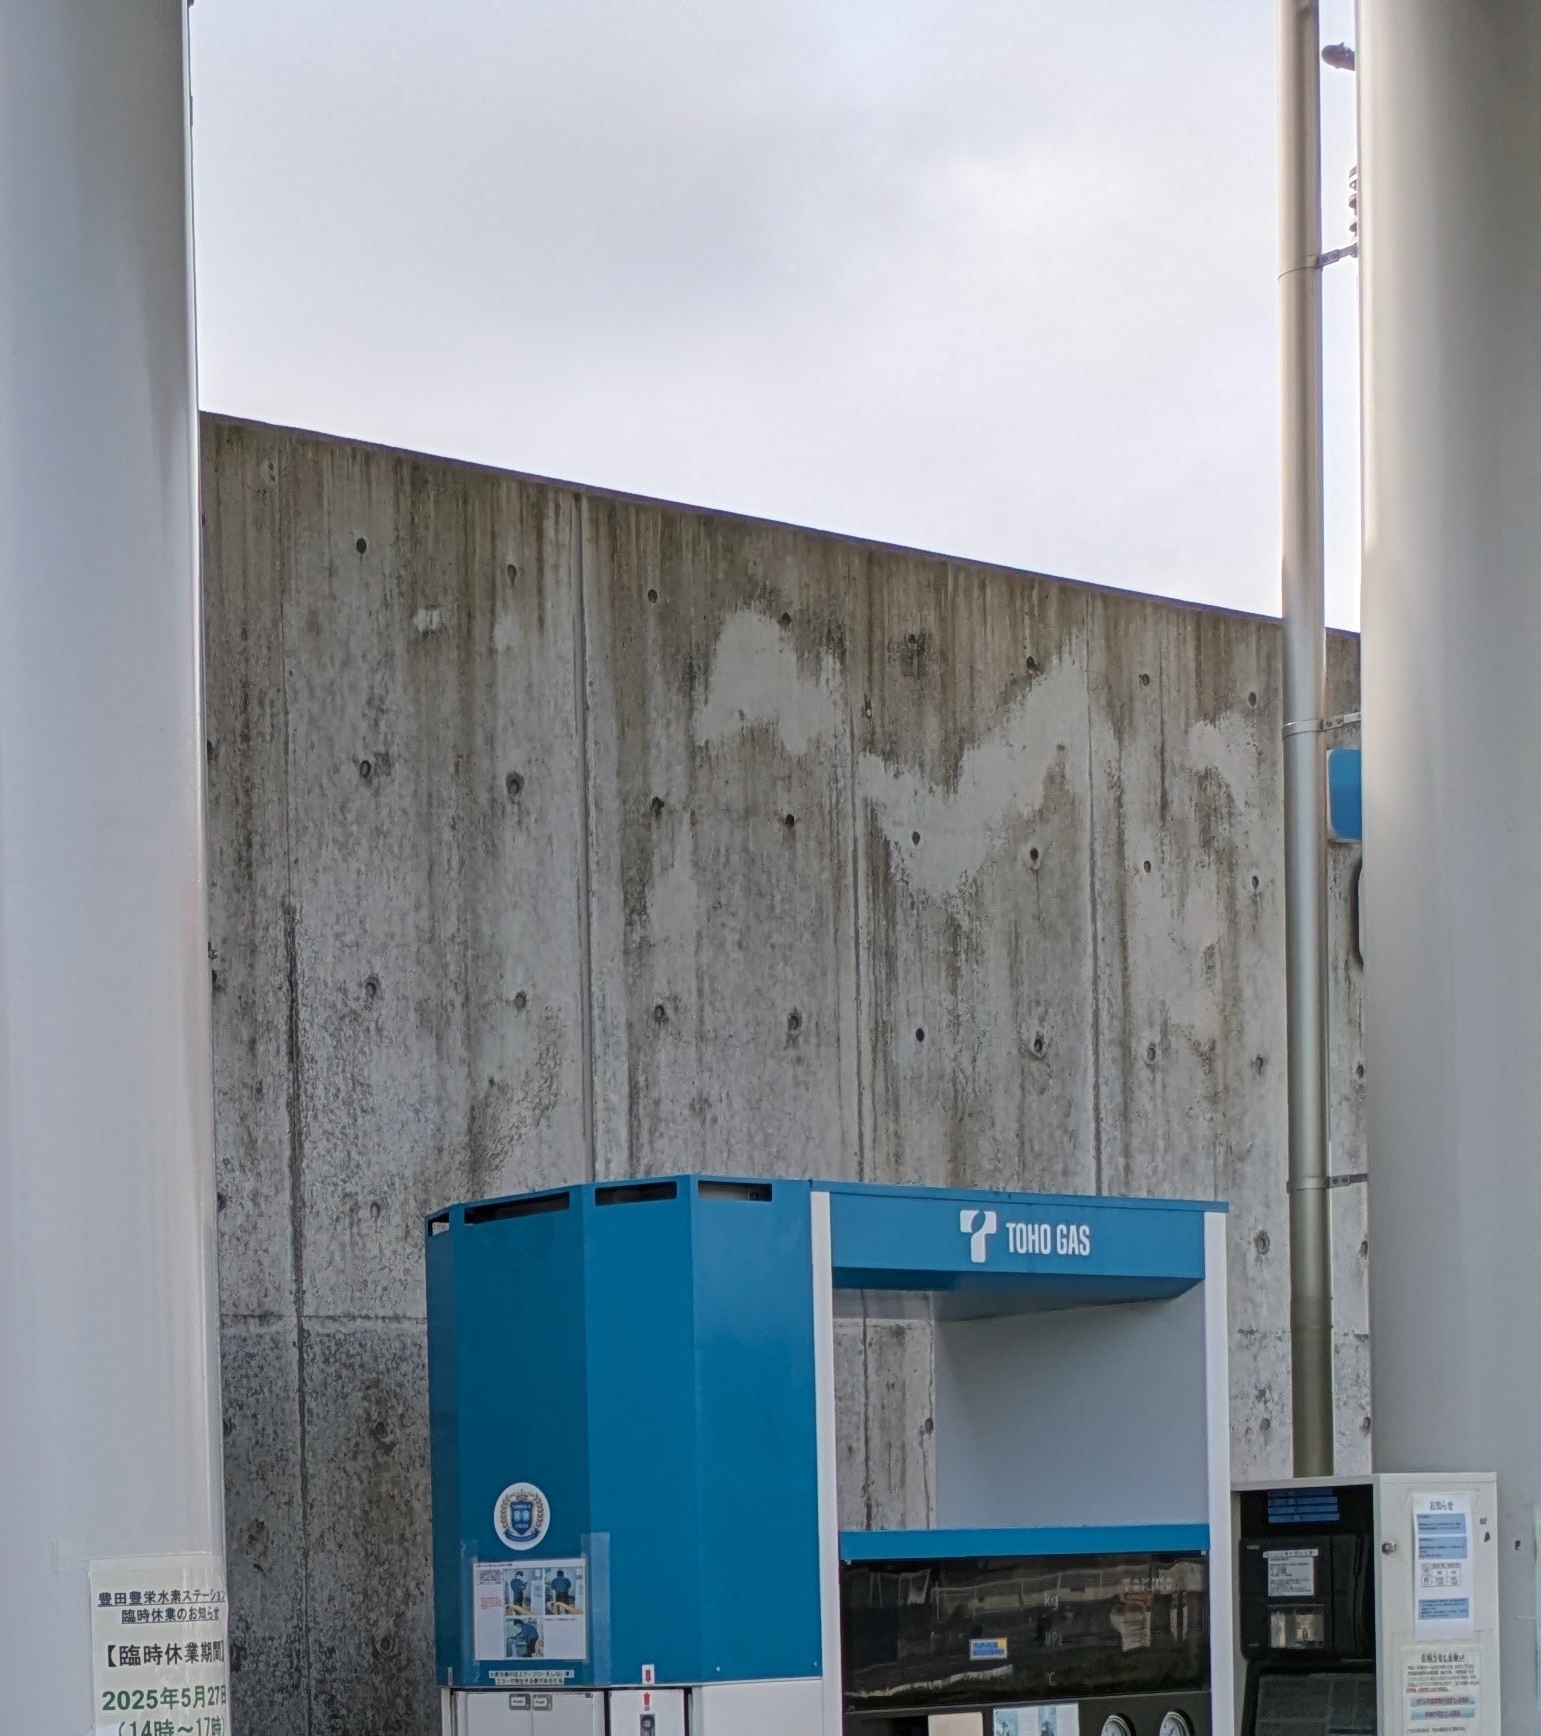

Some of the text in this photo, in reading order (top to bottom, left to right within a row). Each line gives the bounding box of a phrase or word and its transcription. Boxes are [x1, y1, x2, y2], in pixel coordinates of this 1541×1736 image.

[1005, 1222, 1091, 1256] TOHO GAS
[121, 1607, 220, 1623] 臨時休業のお知らせ
[102, 1685, 227, 1711] 2025年5月27日
